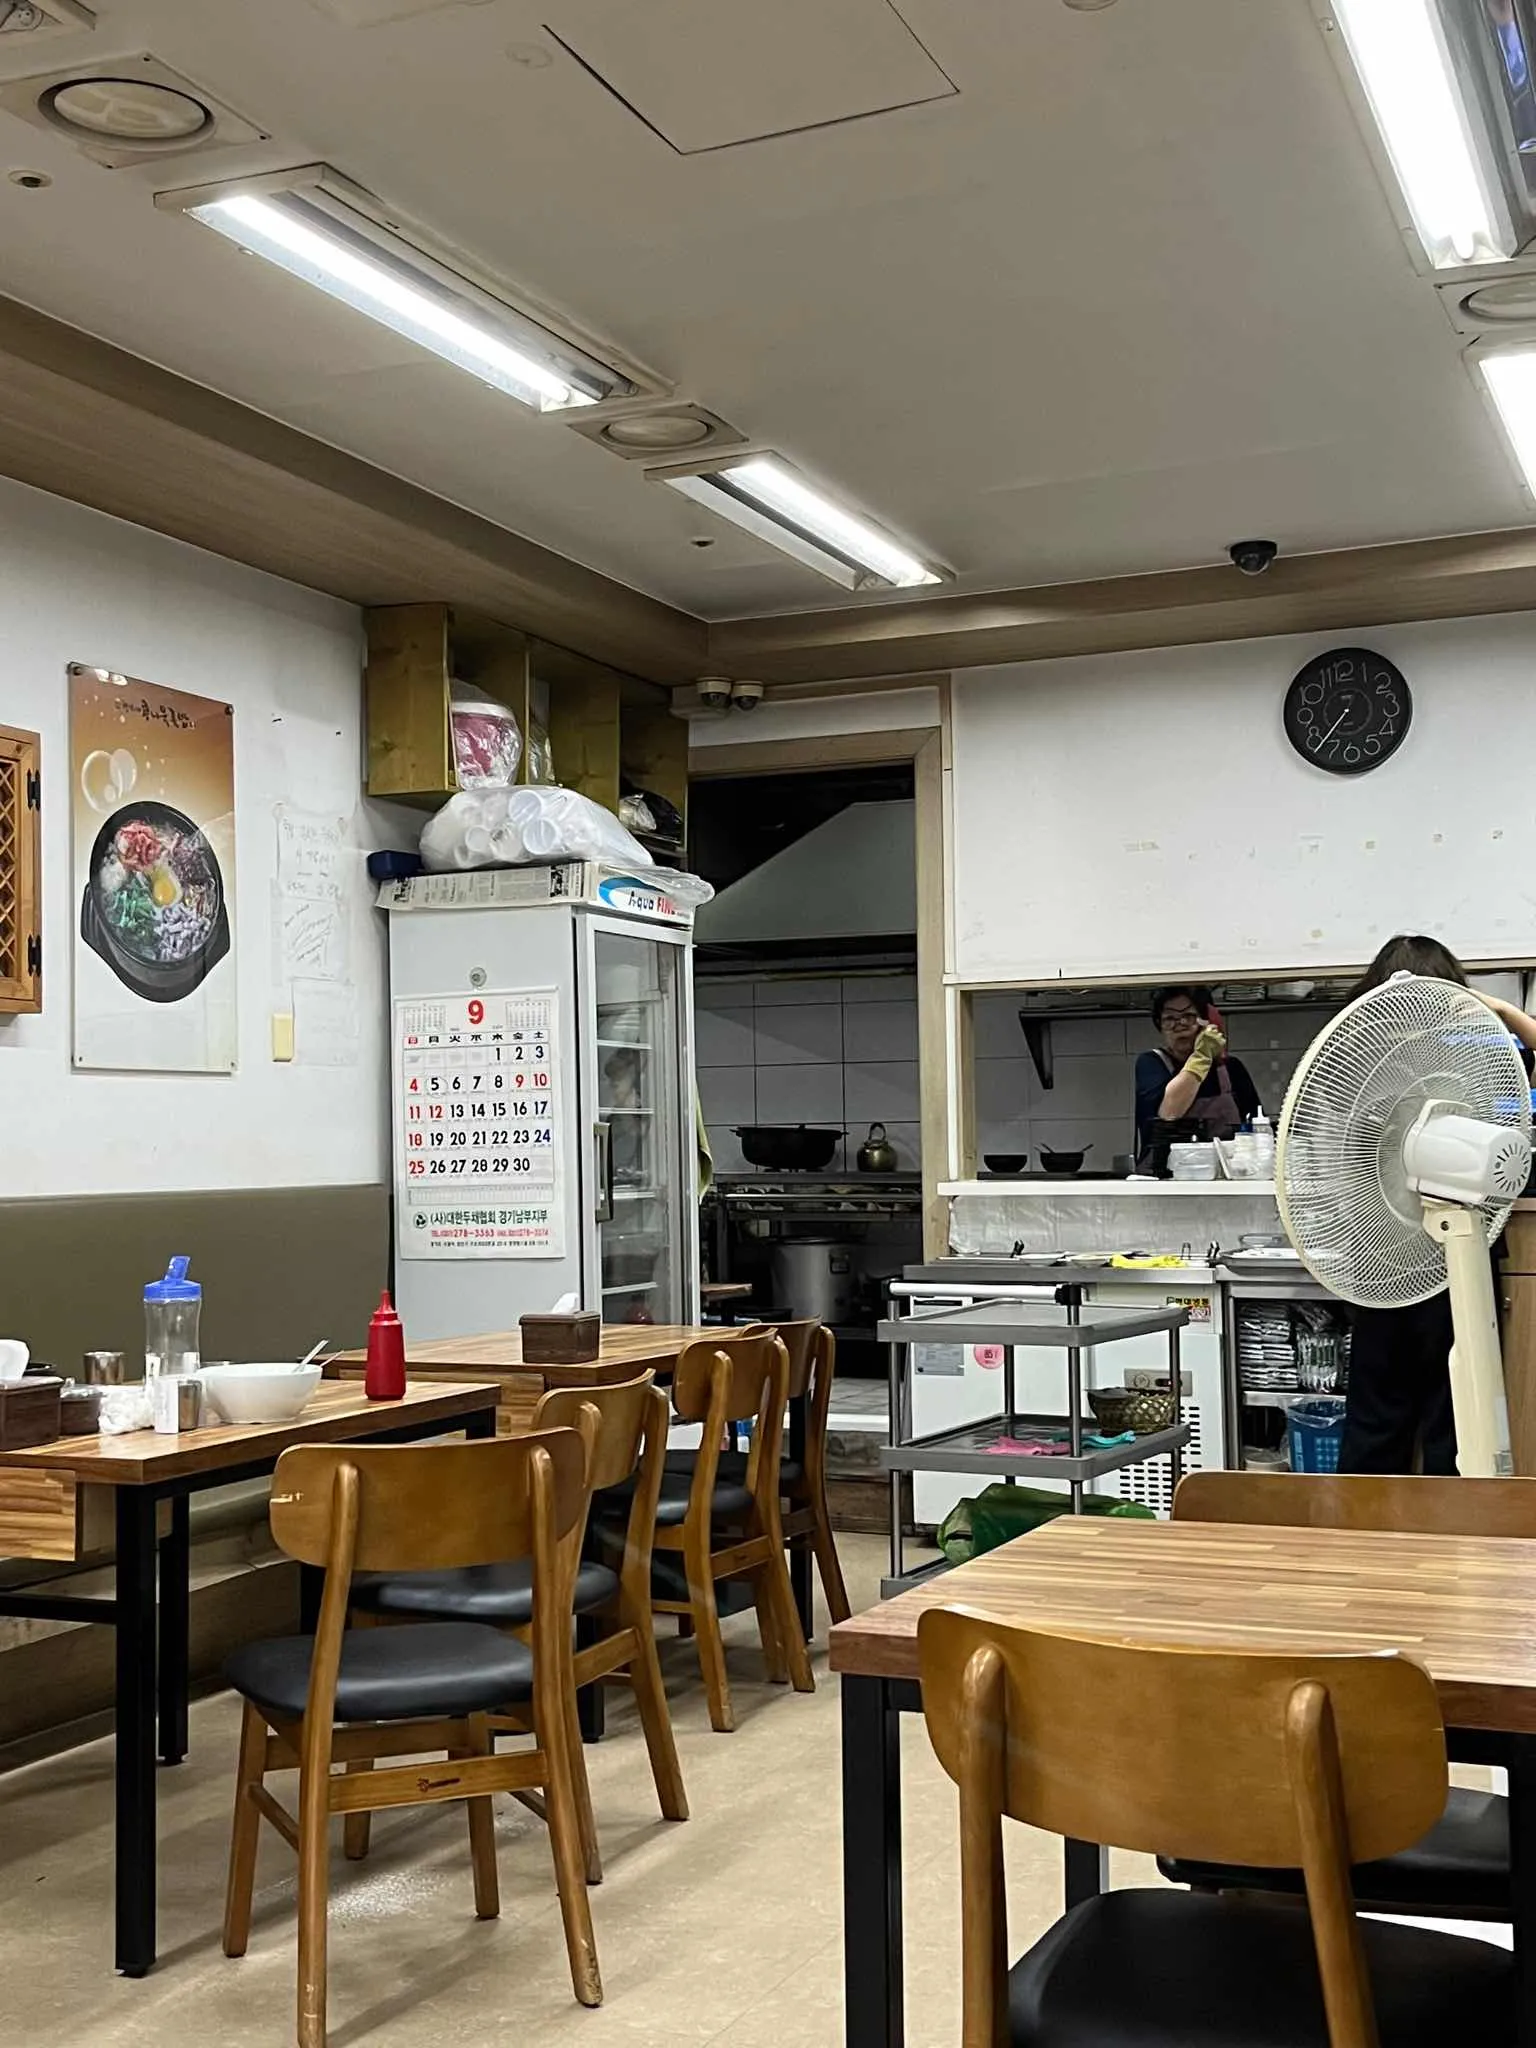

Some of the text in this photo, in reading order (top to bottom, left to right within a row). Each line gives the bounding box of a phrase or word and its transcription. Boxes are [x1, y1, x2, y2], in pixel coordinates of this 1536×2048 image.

[1320, 667, 1333, 689] 11
[1333, 659, 1353, 682] 12
[1361, 661, 1368, 683] 1
[1300, 683, 1324, 705] 10
[1374, 672, 1391, 695] 2
[1383, 692, 1400, 718] 3
[1297, 707, 1314, 728] 9
[1379, 718, 1397, 736] 4
[1306, 726, 1323, 750] 8
[1363, 734, 1381, 755] 5
[1327, 740, 1340, 759] 7
[1343, 742, 1360, 763] 6
[628, 891, 654, 911] Aqua
[468, 1000, 484, 1025] 9
[534, 1031, 544, 1039] 土
[495, 1045, 544, 1061] 1 2 3
[410, 1073, 547, 1091] 4 5 6 7 8 9 10
[409, 1101, 548, 1119] 11 12 13 14 15 16 17
[409, 1129, 551, 1146] 18 19 20 21 22 23 24
[409, 1158, 530, 1174] 25 26 27 28 29 30
